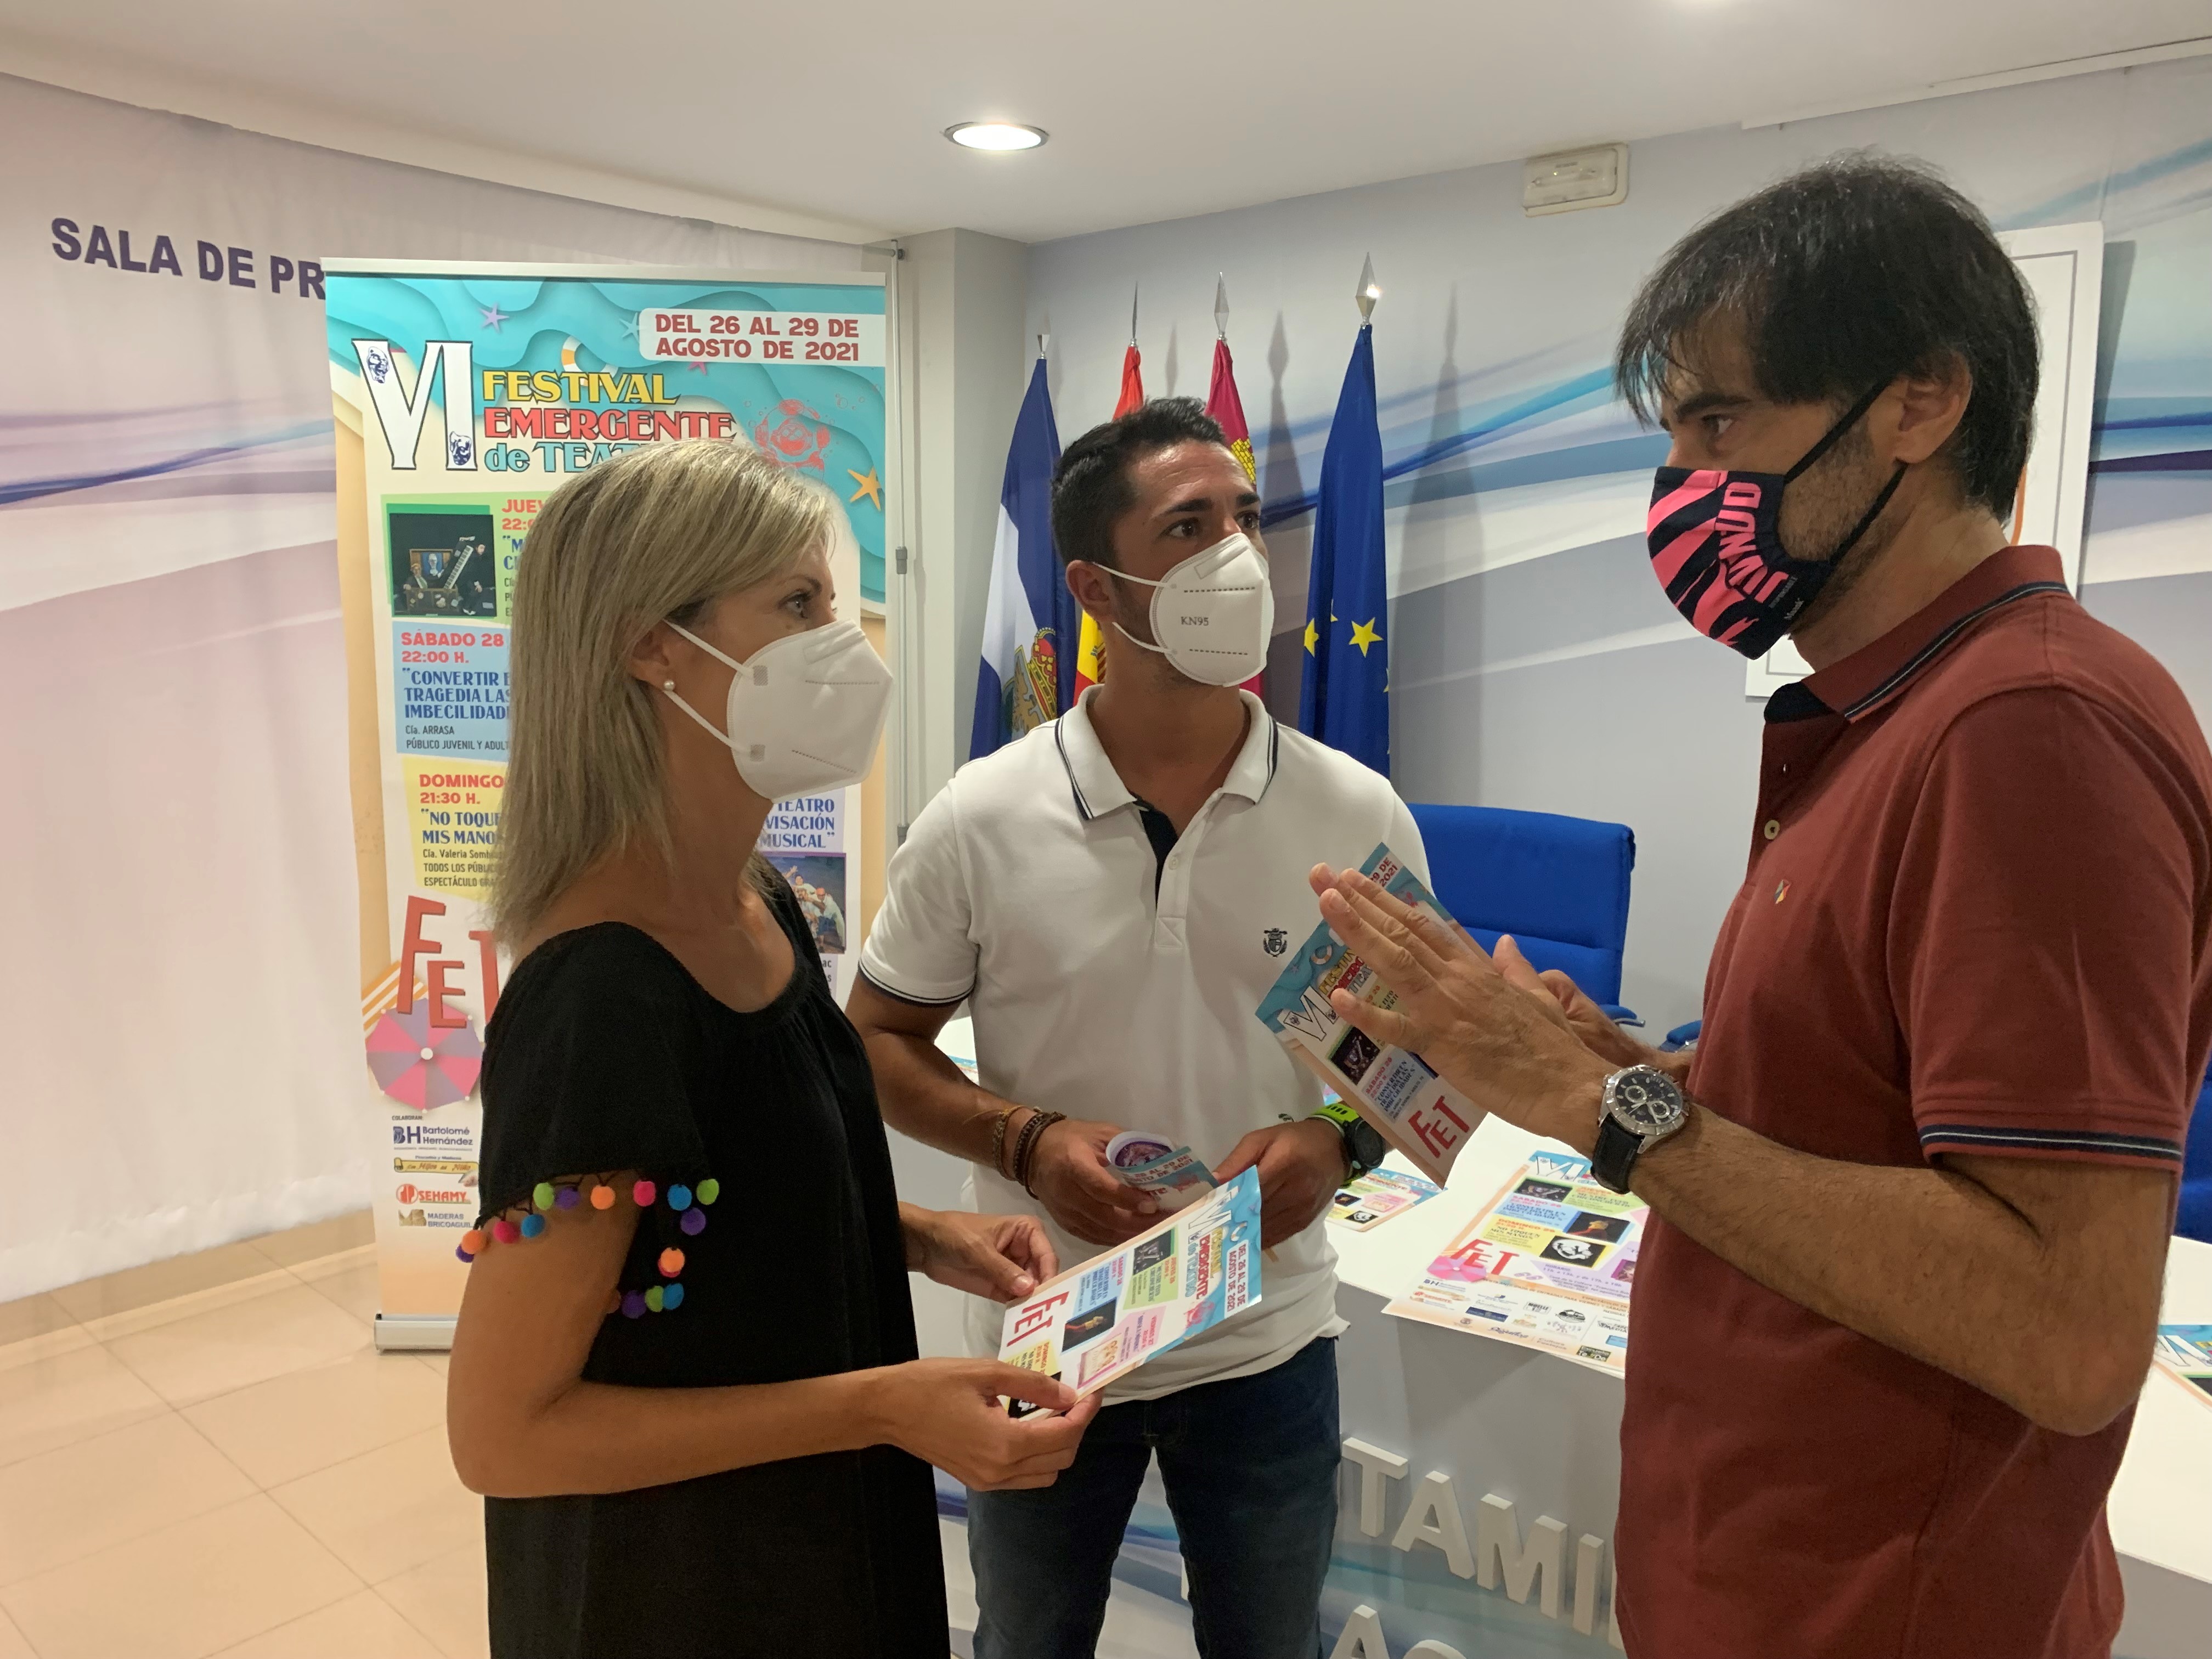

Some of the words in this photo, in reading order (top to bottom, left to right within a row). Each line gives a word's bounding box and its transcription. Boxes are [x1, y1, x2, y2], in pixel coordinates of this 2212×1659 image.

[52, 218, 183, 276] SALA
[197, 240, 256, 288] DE
[655, 314, 702, 334] DEL
[709, 317, 740, 334] 26
[748, 317, 781, 336] AL
[788, 318, 820, 337] 29
[828, 319, 860, 338] DE
[655, 338, 751, 359] AGOSTO
[763, 341, 796, 359] DE
[806, 342, 860, 362] 2021
[483, 370, 680, 405] FESTIVAL
[352, 340, 478, 471] VI
[484, 408, 736, 442] EMERGENTE
[484, 443, 530, 472] de
[1181, 616, 1209, 627] KN95
[481, 633, 504, 647] 28
[402, 651, 449, 663] 22:00
[454, 652, 469, 663] H.
[404, 688, 481, 702] TRAGEDIA
[422, 726, 455, 735] ARRASA
[407, 737, 439, 749] PÚBLICO
[442, 740, 475, 750] JUVENIL
[477, 741, 482, 749] Y
[419, 774, 504, 788] DOMINGO
[420, 792, 461, 804] 21:30
[466, 793, 481, 804] H.
[422, 830, 450, 844] MIS
[439, 849, 467, 859] Valeria
[424, 863, 449, 872] TODOS
[452, 863, 465, 872] LOS
[1379, 857, 1392, 872] DE
[1379, 864, 1398, 887] 2021
[1283, 985, 1339, 1042] VI
[423, 1127, 470, 1135] Bartolomé
[1408, 1096, 1470, 1159] FET
[393, 1126, 420, 1144] BH
[423, 1137, 473, 1145] Hernández
[1536, 1156, 1585, 1182] VI
[419, 1190, 466, 1202] SEHAMY
[1238, 1244, 1246, 1261] DEL
[1450, 1238, 1519, 1276] FET
[1196, 1234, 1210, 1300] EMERGENTE
[1238, 1262, 1245, 1271] 26
[1238, 1272, 1245, 1282] AL
[1228, 1282, 1235, 1291] DE
[1238, 1284, 1245, 1294] 29
[1227, 1295, 1235, 1312] 2021
[1237, 1295, 1245, 1307] DE
[1006, 1291, 1070, 1347] FET
